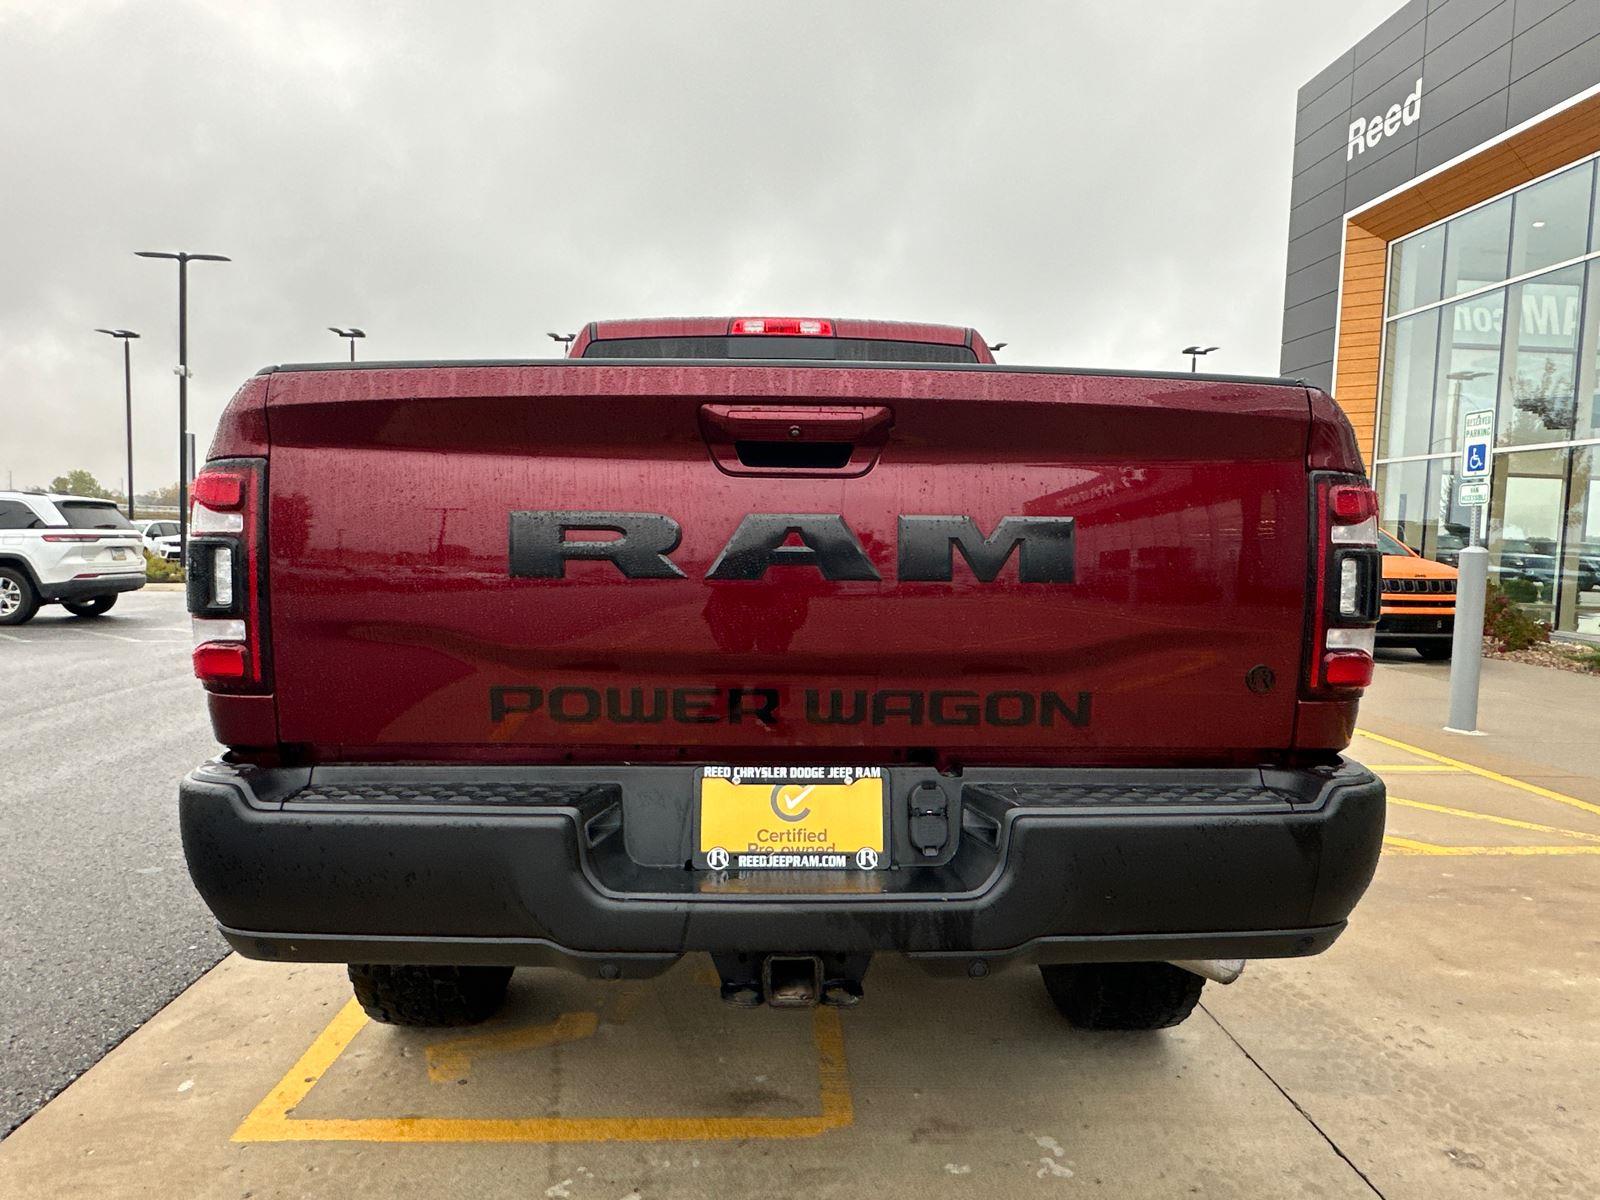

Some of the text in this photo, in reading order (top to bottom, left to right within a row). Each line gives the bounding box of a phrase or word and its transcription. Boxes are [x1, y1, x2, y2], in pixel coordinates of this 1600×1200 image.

[1347, 78, 1422, 161] Reed
[1466, 428, 1490, 438] PARKING
[509, 511, 1076, 583] RAM
[489, 685, 1092, 728] POWER WAGON
[704, 766, 881, 779] REED CHRYSLER DODGE JEEP RAM
[757, 829, 827, 842] Certified
[738, 855, 846, 868] REEDJEEPRAM.COM
